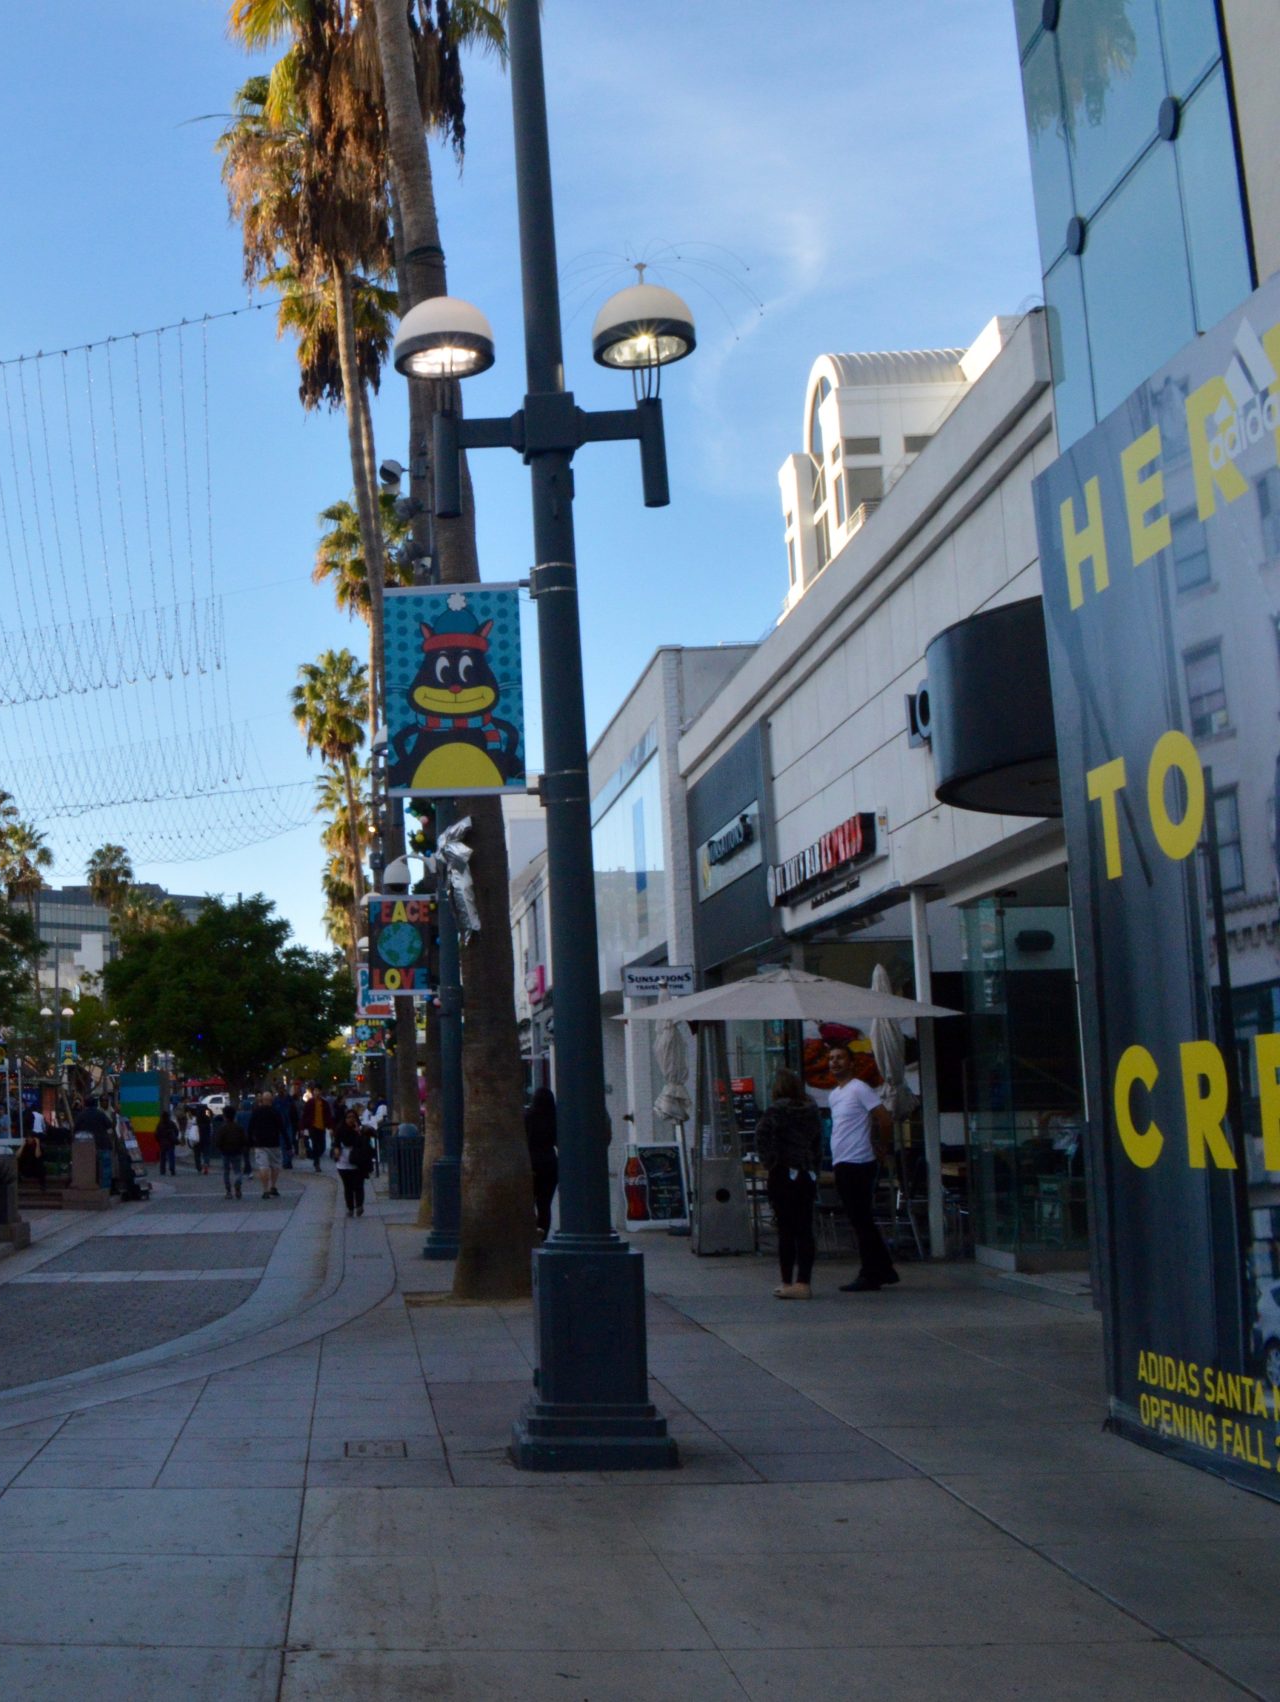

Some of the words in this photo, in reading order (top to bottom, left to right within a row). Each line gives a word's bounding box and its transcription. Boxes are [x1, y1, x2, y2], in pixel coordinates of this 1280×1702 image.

[1086, 730, 1205, 880] TO
[369, 900, 430, 923] PEACE
[372, 968, 428, 990] LOVE
[627, 972, 692, 984] SUNSATIONS
[1138, 1349, 1200, 1398] ADIDAS
[1204, 1367, 1268, 1419] SANTA
[1140, 1393, 1217, 1450] OPENING
[1222, 1418, 1271, 1469] FALL
